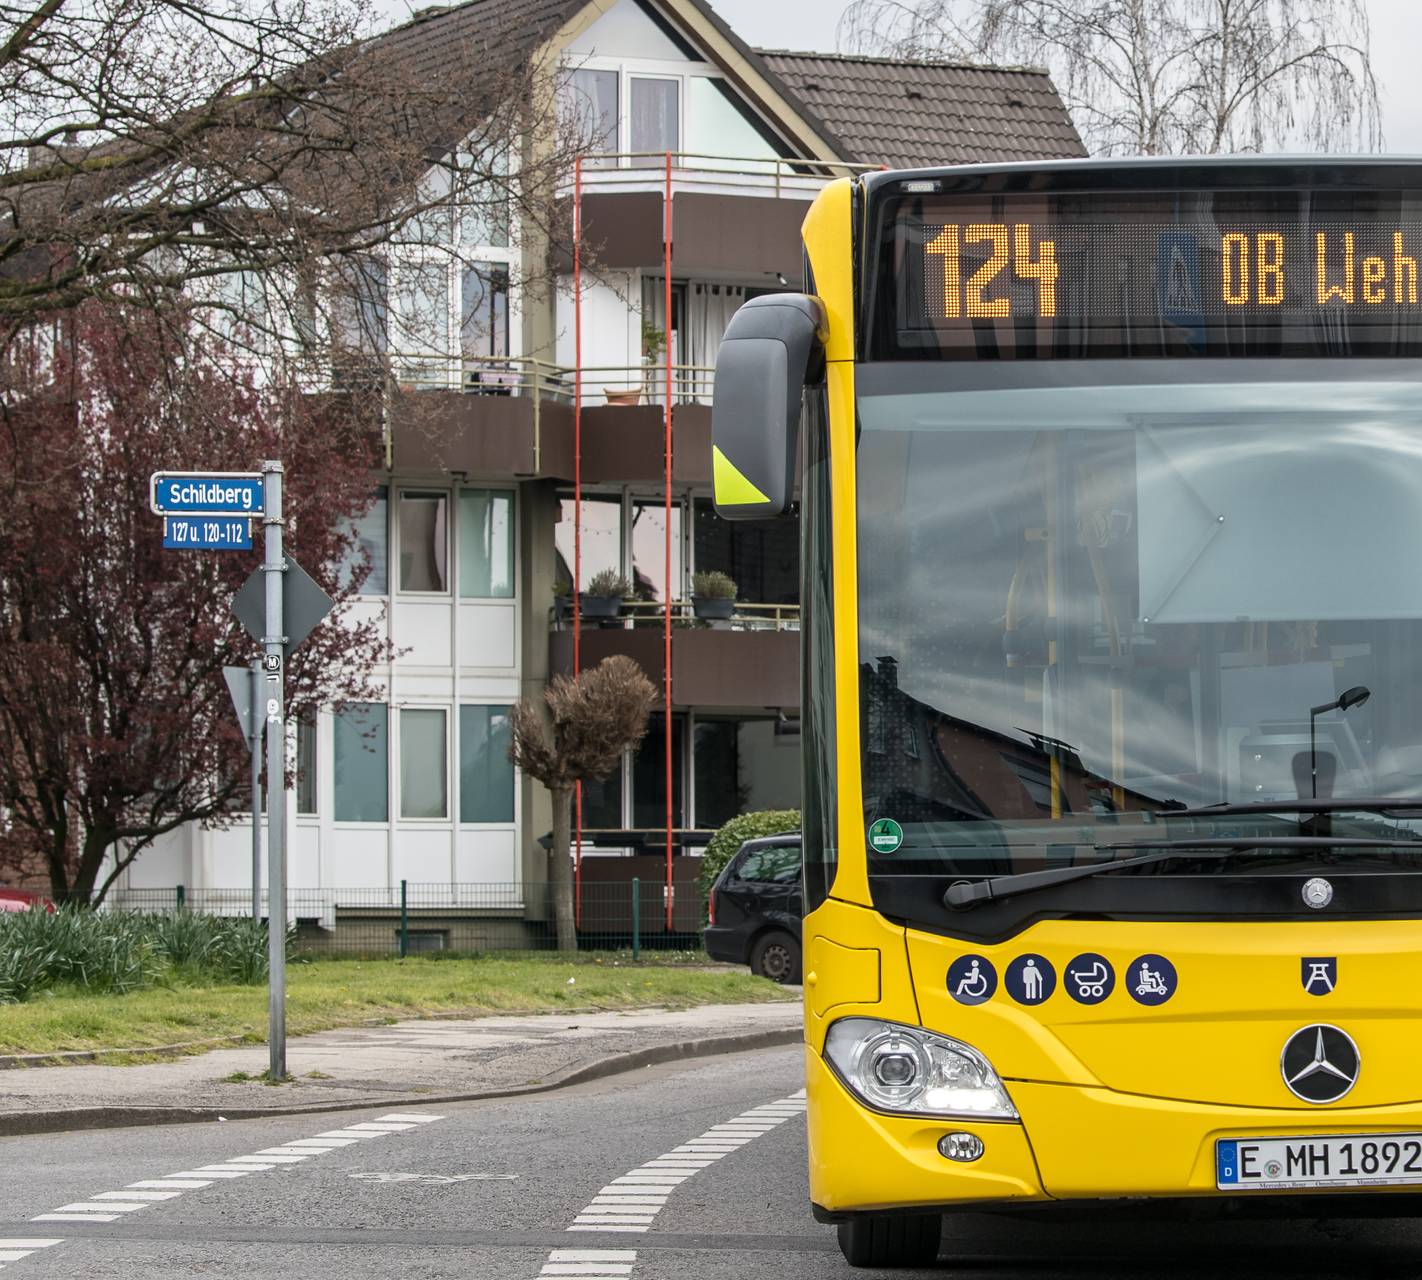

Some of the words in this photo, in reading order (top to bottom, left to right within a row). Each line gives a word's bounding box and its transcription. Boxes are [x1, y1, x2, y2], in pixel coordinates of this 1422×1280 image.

[926, 224, 1060, 318] 124
[1221, 231, 1285, 305] OB
[169, 483, 252, 509] Schildberg
[172, 522, 189, 542] 127
[190, 526, 200, 542] u.
[203, 522, 243, 543] 120-112
[1224, 1167, 1233, 1177] D
[1240, 1146, 1262, 1178] E
[1286, 1143, 1330, 1177] MH
[1339, 1141, 1422, 1175] 1892
